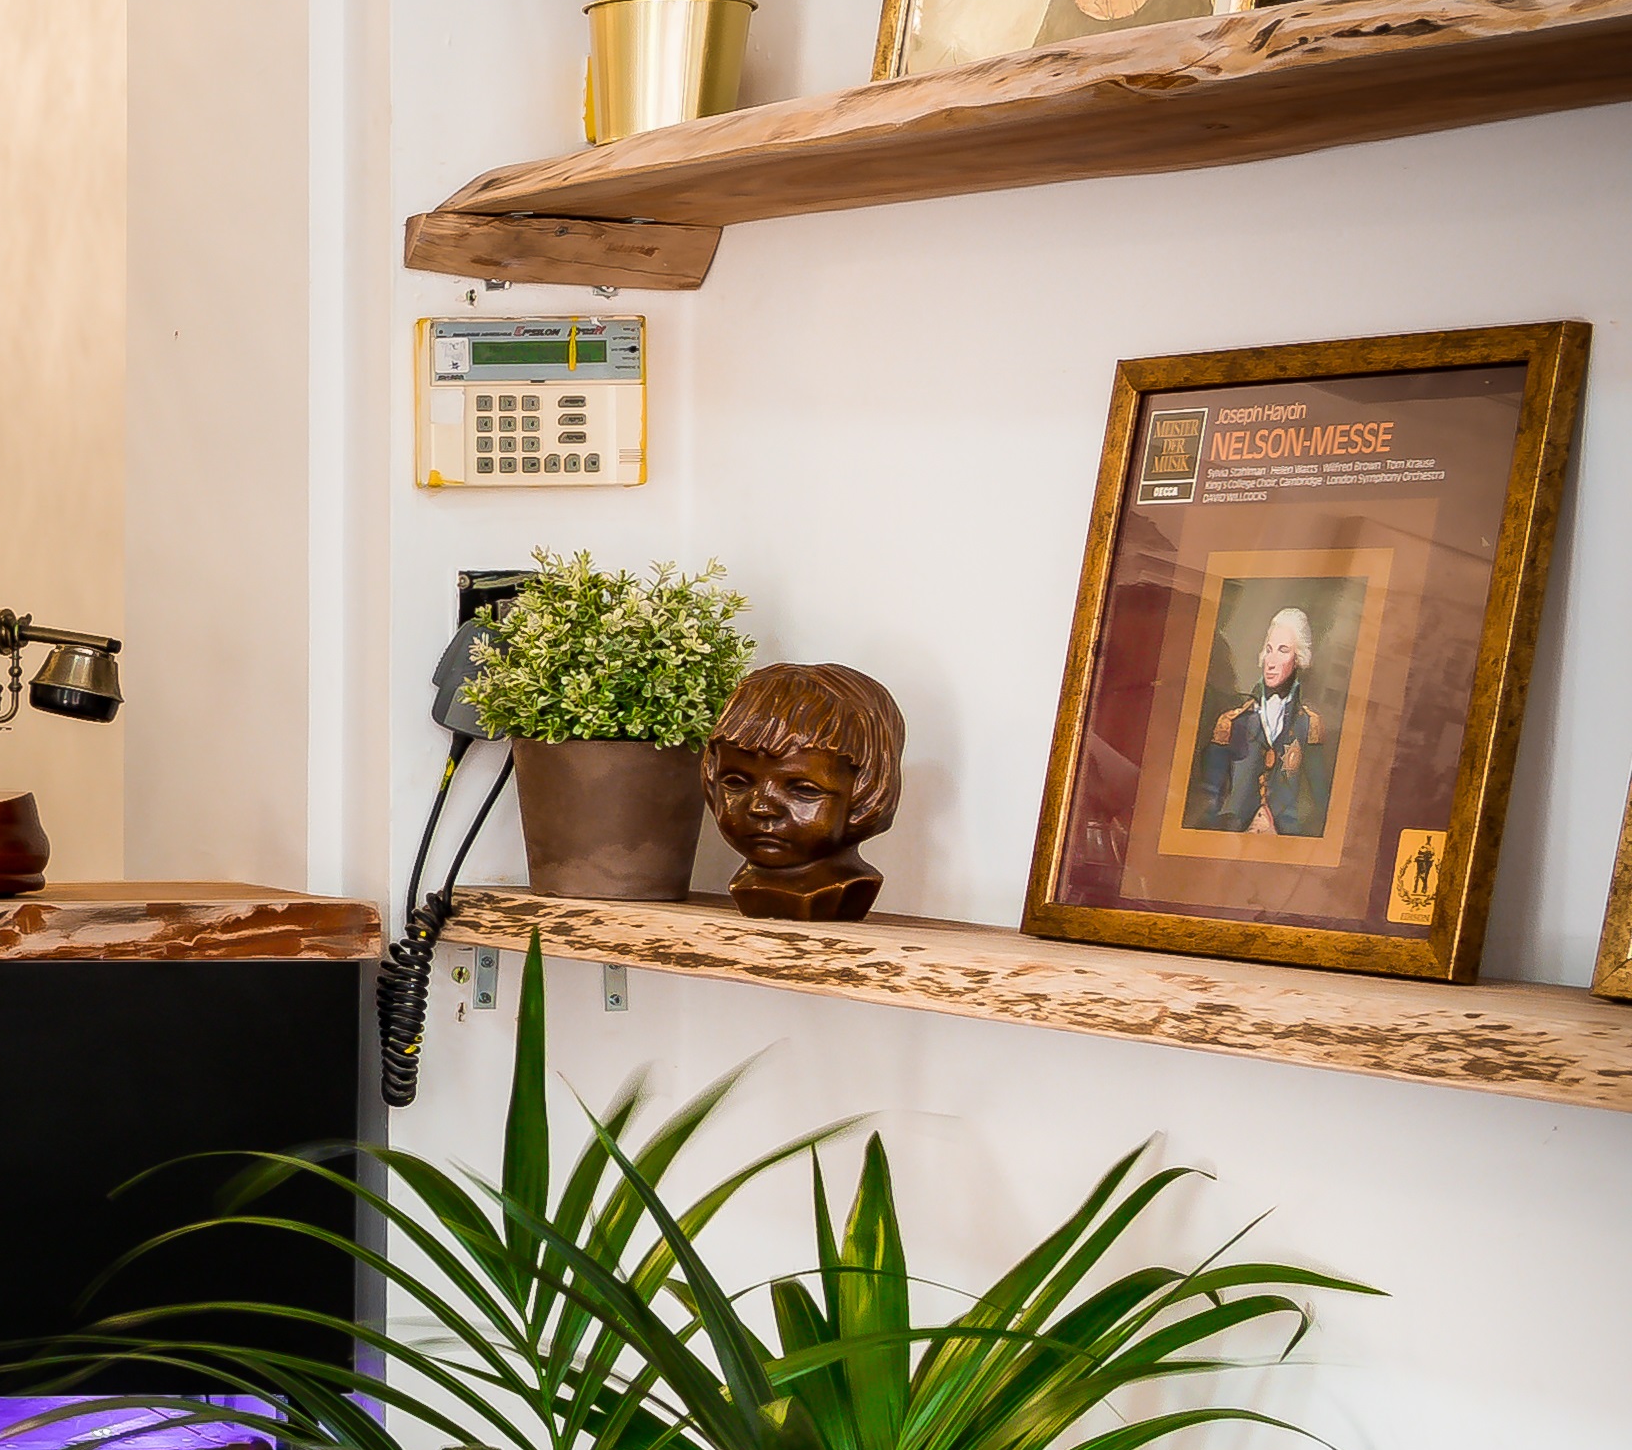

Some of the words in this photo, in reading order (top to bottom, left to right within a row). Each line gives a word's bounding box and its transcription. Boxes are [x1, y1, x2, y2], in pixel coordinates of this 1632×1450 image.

[1215, 406, 1262, 426] Joseph
[1263, 402, 1307, 423] Haydn
[1161, 438, 1186, 455] DER
[1210, 422, 1395, 461] NELSON-MESSE
[1151, 455, 1191, 473] MUSIK
[1326, 474, 1357, 485] London
[1358, 472, 1403, 485] Symphony
[1153, 486, 1179, 498] DECCA
